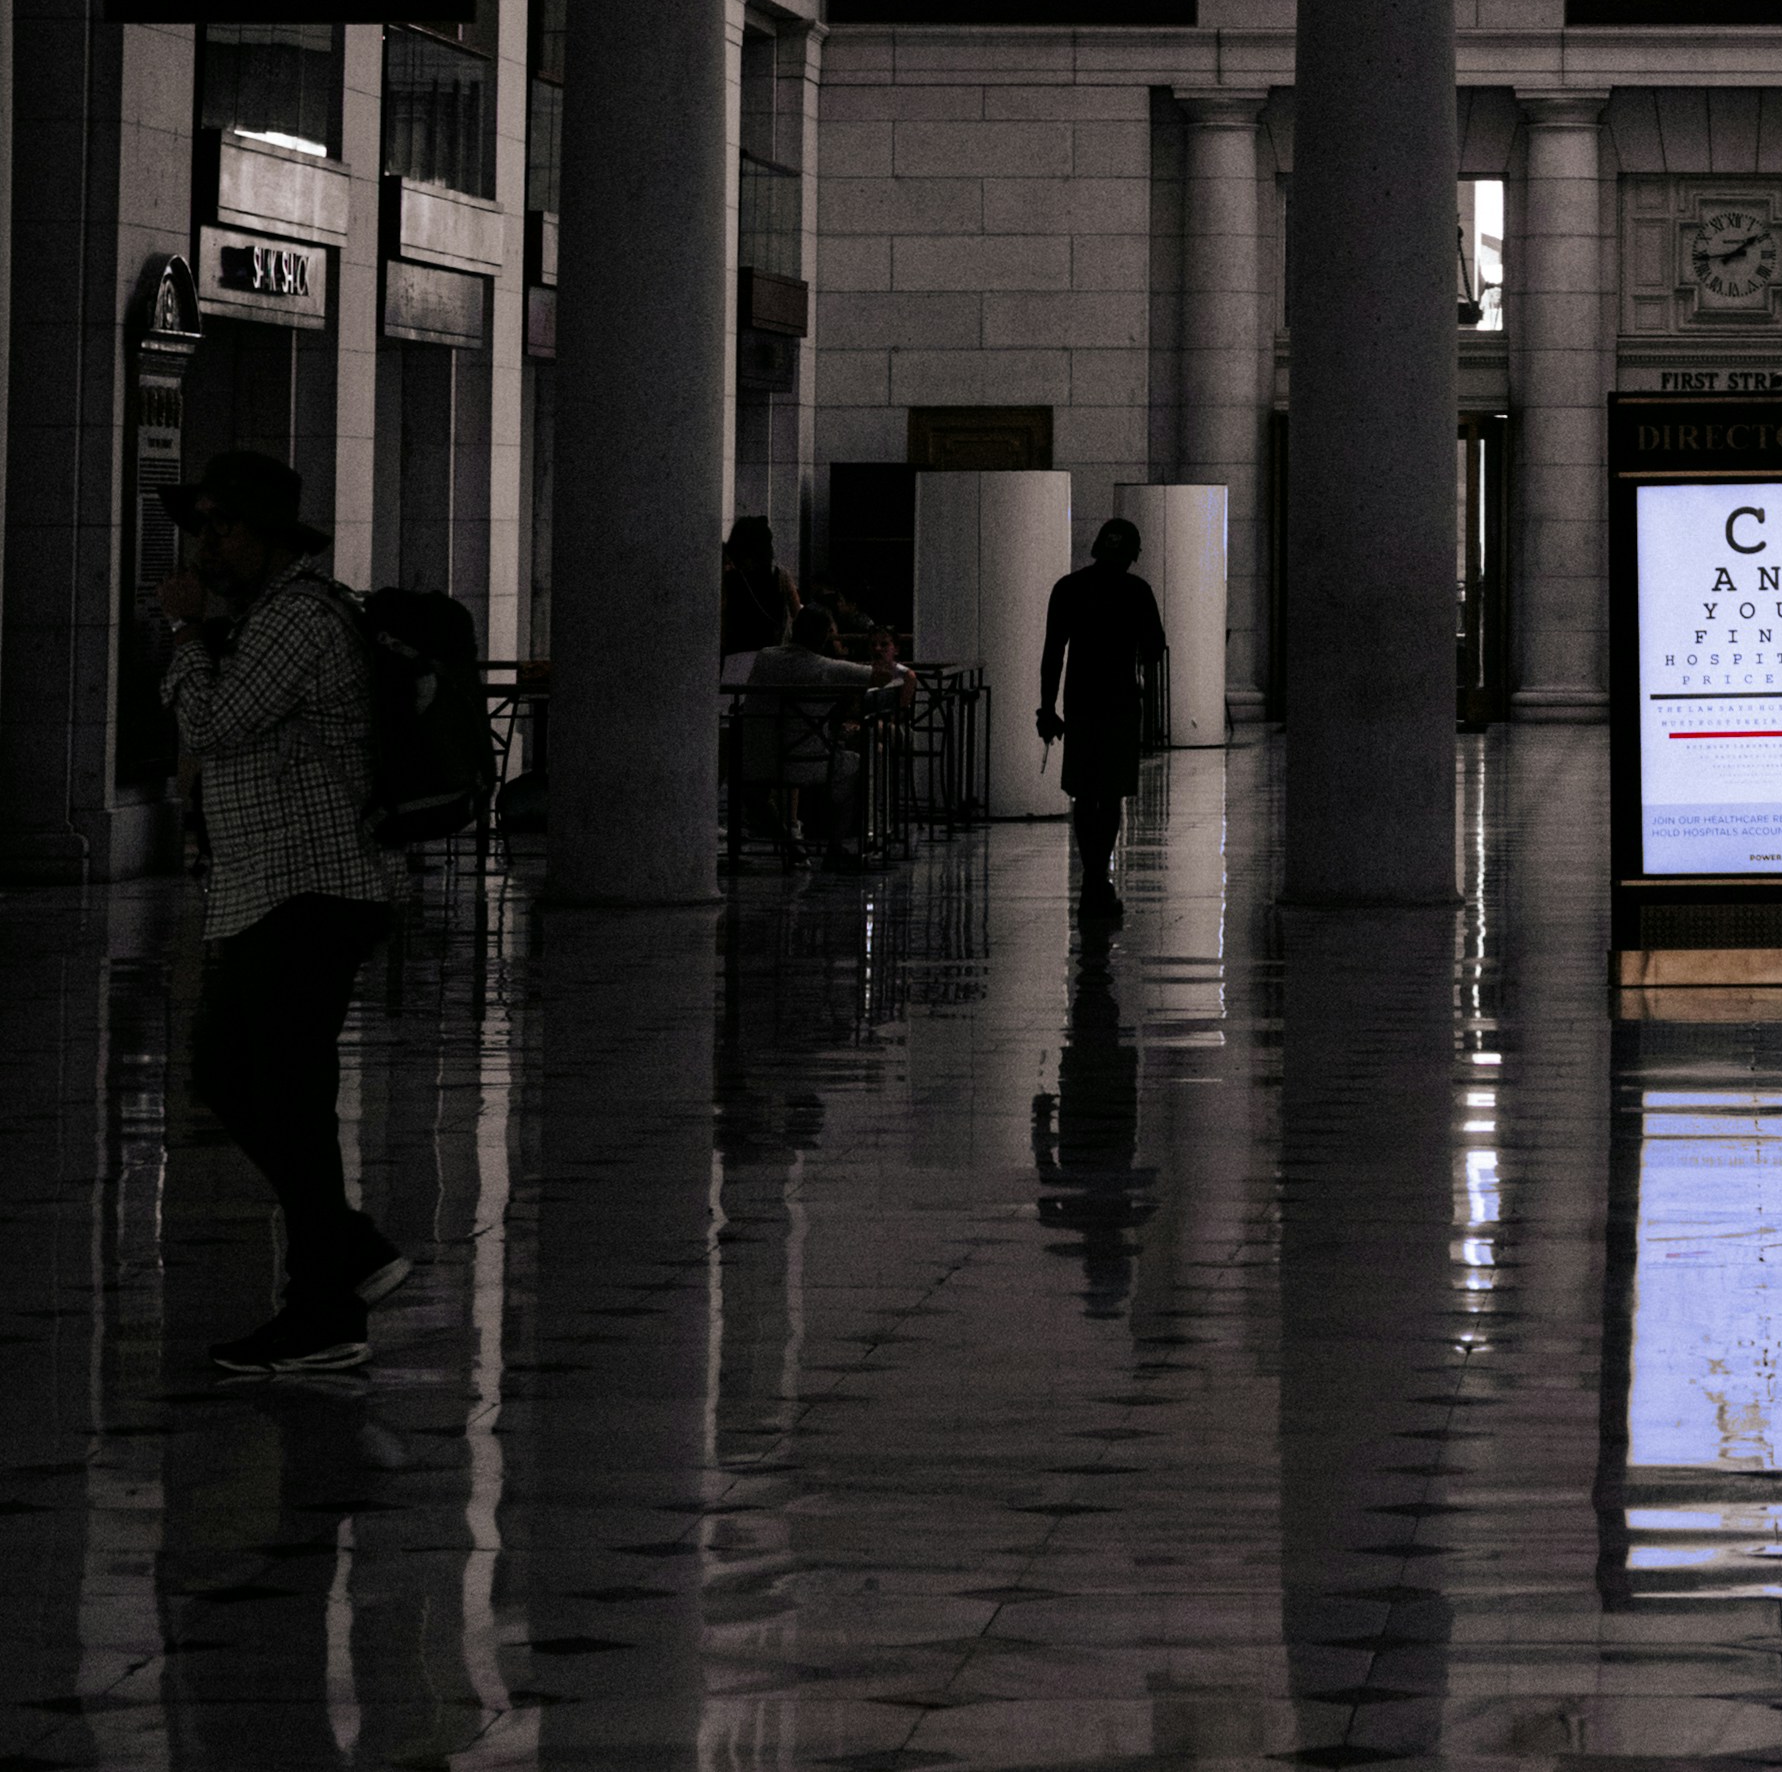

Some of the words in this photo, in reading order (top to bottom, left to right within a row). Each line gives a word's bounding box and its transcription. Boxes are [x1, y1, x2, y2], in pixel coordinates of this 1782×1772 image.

[252, 245, 279, 292] SHK
[281, 251, 311, 297] SHCK
[1660, 372, 1720, 390] FIRST
[1725, 506, 1767, 555] C
[1711, 566, 1782, 592] AN
[1657, 705, 1682, 714] THE
[1688, 705, 1714, 713] LAW
[1719, 704, 1753, 713] SAYS
[1651, 816, 1676, 825] JOIN
[1678, 815, 1700, 825] OUR
[1703, 814, 1769, 824] HEALTHCARE
[1651, 828, 1680, 837] HOLD
[1683, 827, 1739, 837] HOSPITALS
